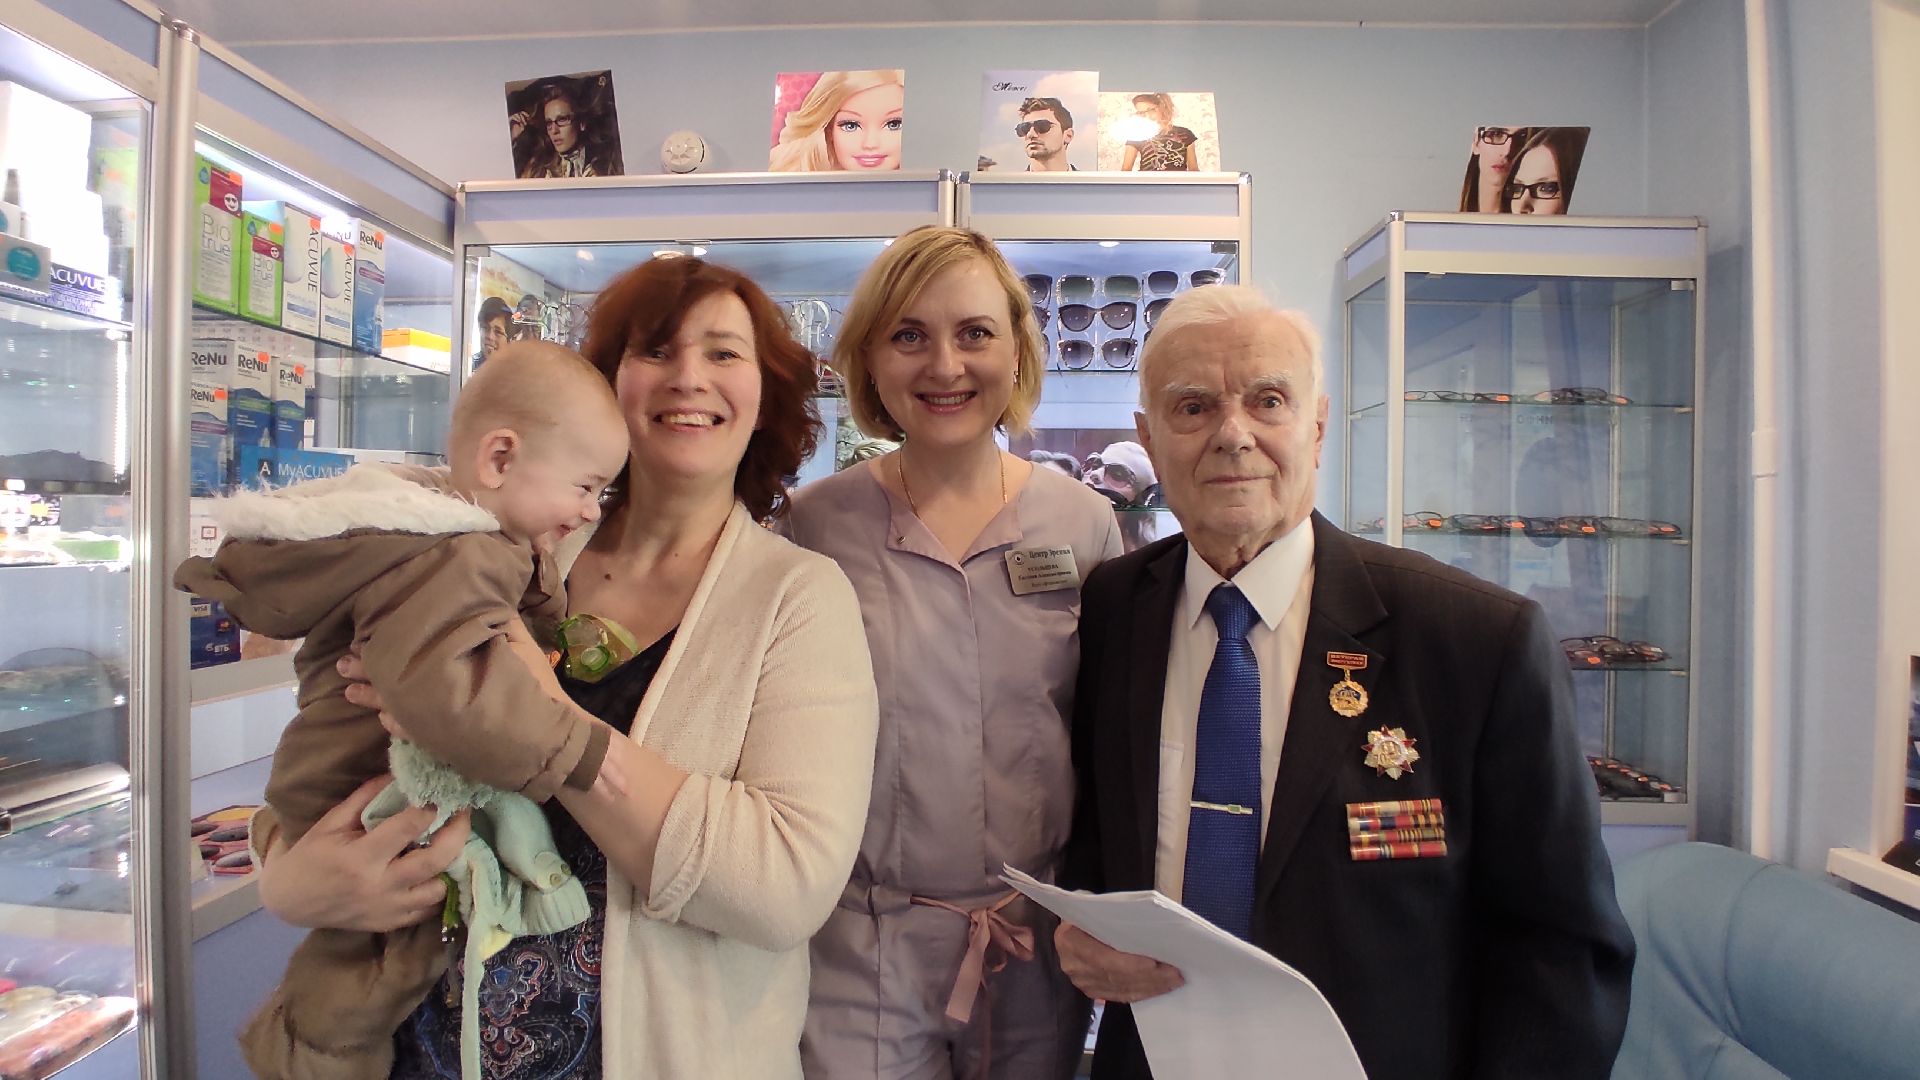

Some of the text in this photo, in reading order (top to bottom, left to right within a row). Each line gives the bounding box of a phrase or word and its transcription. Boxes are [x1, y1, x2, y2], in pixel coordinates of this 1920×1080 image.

[202, 234, 231, 256] true
[359, 230, 383, 251] ReNu
[308, 227, 319, 293] ACUVUE
[343, 255, 352, 304] ACUVUE
[191, 351, 227, 366] ReNu
[238, 353, 268, 372] ReNu
[280, 369, 302, 385] ReNu
[191, 389, 215, 403] ReNu
[193, 604, 208, 612] VISA
